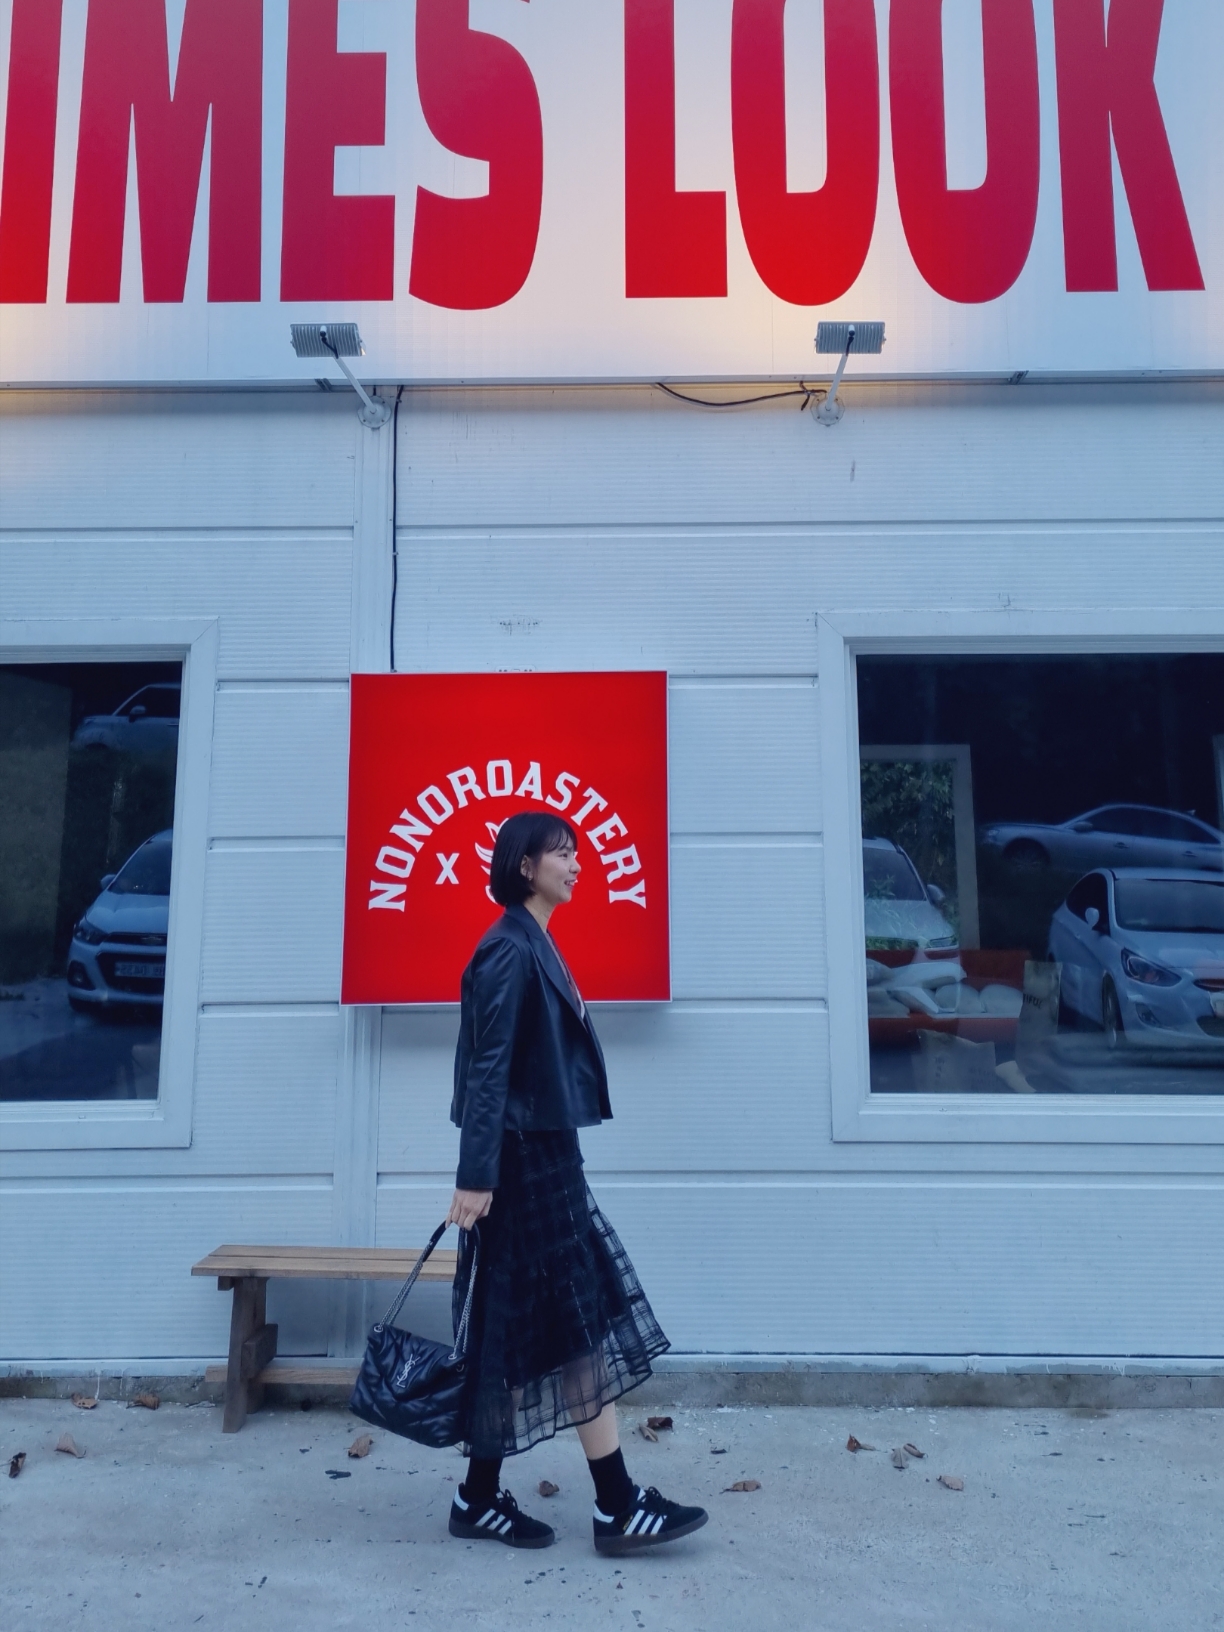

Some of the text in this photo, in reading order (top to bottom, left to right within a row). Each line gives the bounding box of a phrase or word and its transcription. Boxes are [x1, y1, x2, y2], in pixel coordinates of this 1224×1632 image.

[0, 0, 1205, 309] IMES LOOK
[368, 759, 647, 912] NONOROASTERY
